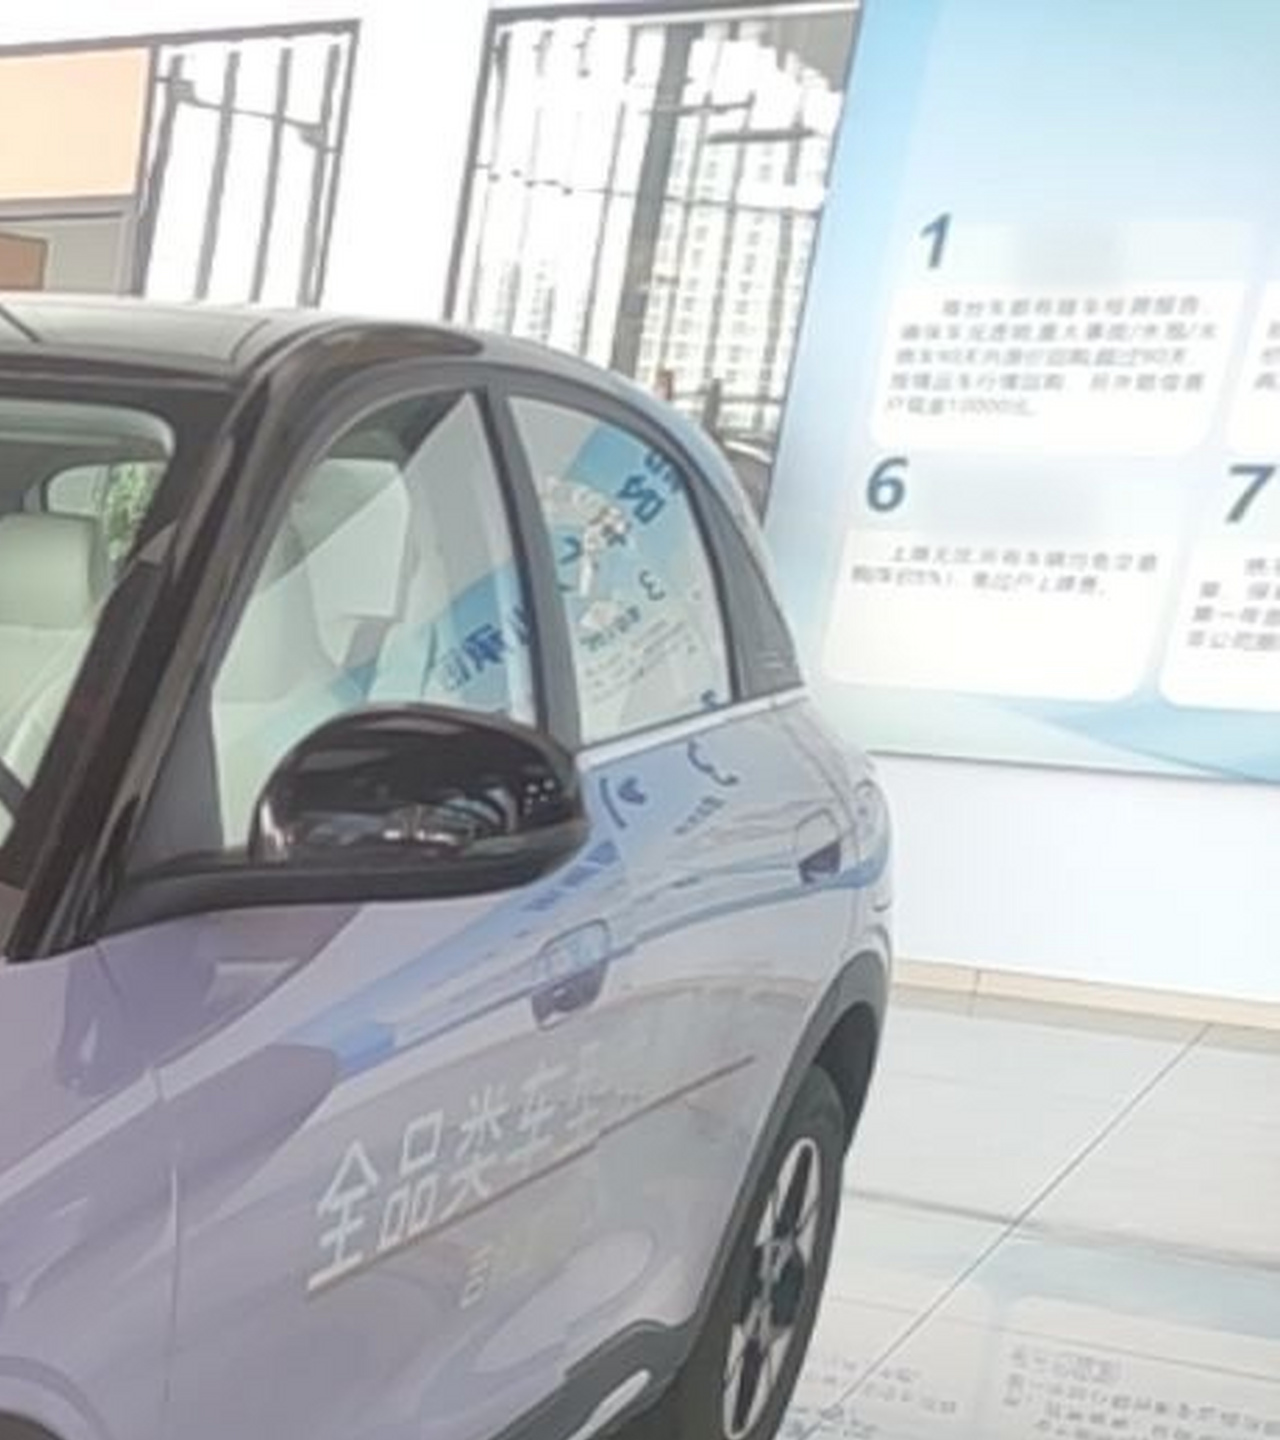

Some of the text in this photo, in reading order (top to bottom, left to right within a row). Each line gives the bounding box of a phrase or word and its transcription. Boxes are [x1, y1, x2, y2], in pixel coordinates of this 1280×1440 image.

[920, 211, 952, 270] 1
[865, 455, 910, 514] 6
[1225, 462, 1277, 526] 7
